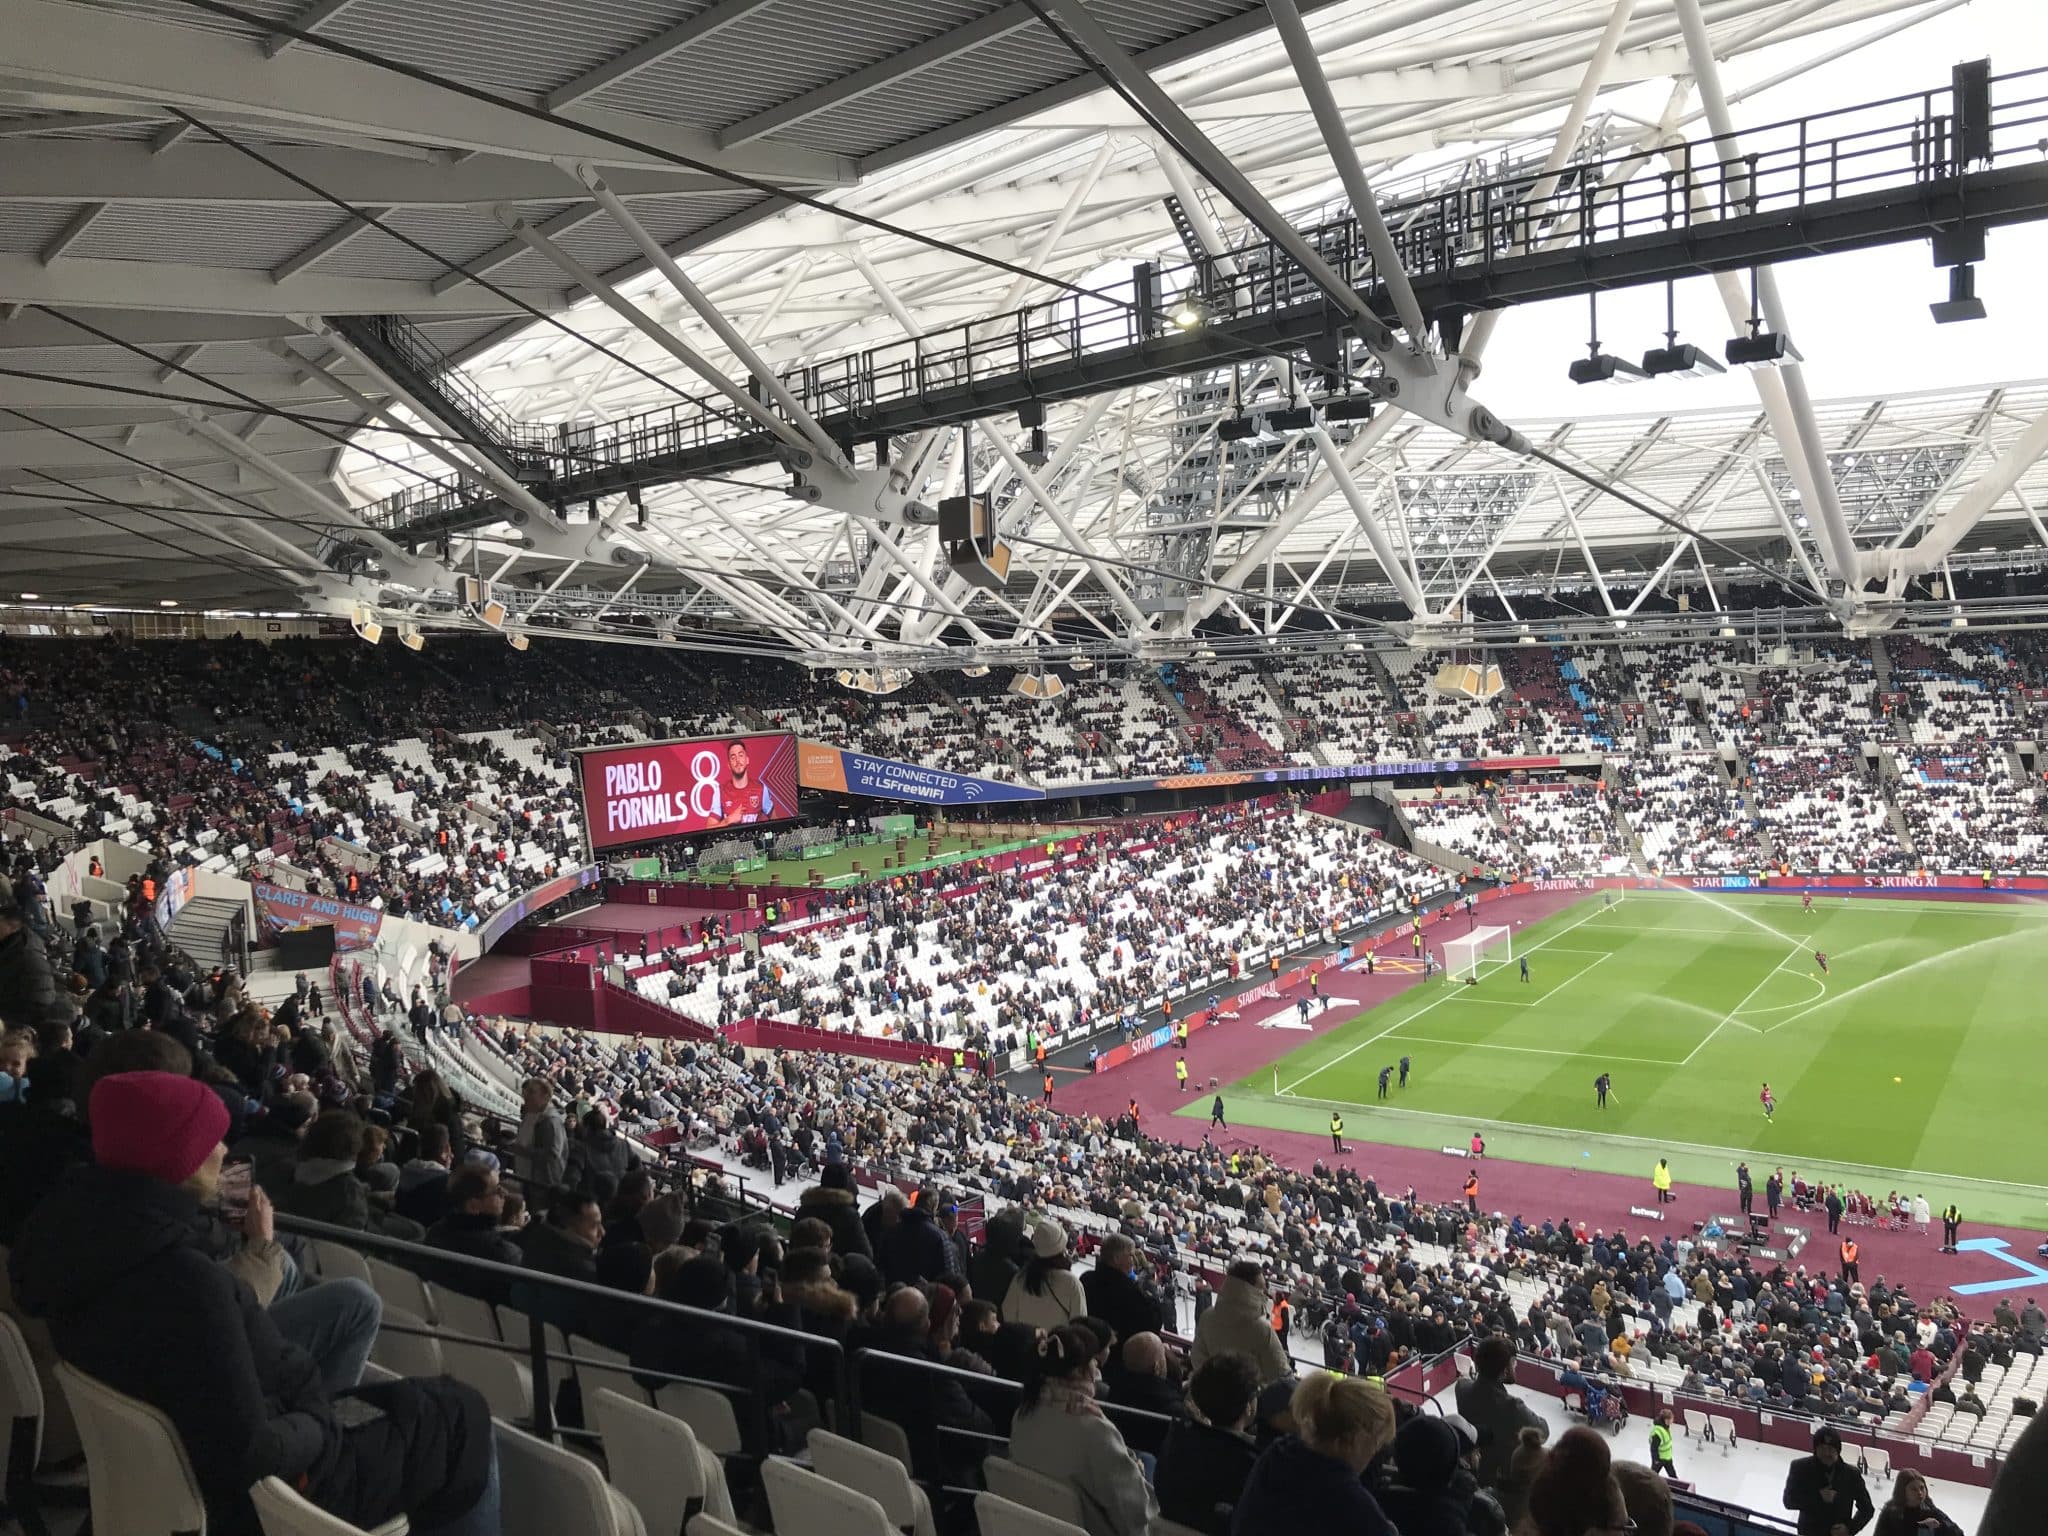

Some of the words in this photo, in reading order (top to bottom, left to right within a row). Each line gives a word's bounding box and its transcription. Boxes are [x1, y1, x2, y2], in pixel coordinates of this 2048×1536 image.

[853, 758, 884, 773] STAY
[885, 765, 958, 789] CONNECTED
[1350, 765, 1372, 777] FOR
[1376, 762, 1437, 776] HALFTIME
[605, 760, 662, 797] PABLO
[690, 751, 720, 817] 8
[861, 775, 873, 787] at
[608, 791, 688, 832] FORNALS
[1584, 879, 1594, 889] XI
[1693, 877, 1747, 888] STARTING
[1748, 877, 1759, 888] XI
[1864, 876, 1922, 888] SARTING
[1925, 877, 1938, 888] XI
[255, 885, 308, 908] CLARET
[311, 899, 339, 916] AND
[342, 905, 378, 924] HUGH
[1131, 1025, 1170, 1057] STARTING
[1443, 1146, 1466, 1157] betway
[1631, 1205, 1660, 1219] betway
[1718, 1216, 1735, 1225] VAR
[1783, 1226, 1800, 1236] VAR
[1701, 1239, 1718, 1249] VAR
[1759, 1249, 1777, 1259] VAR
